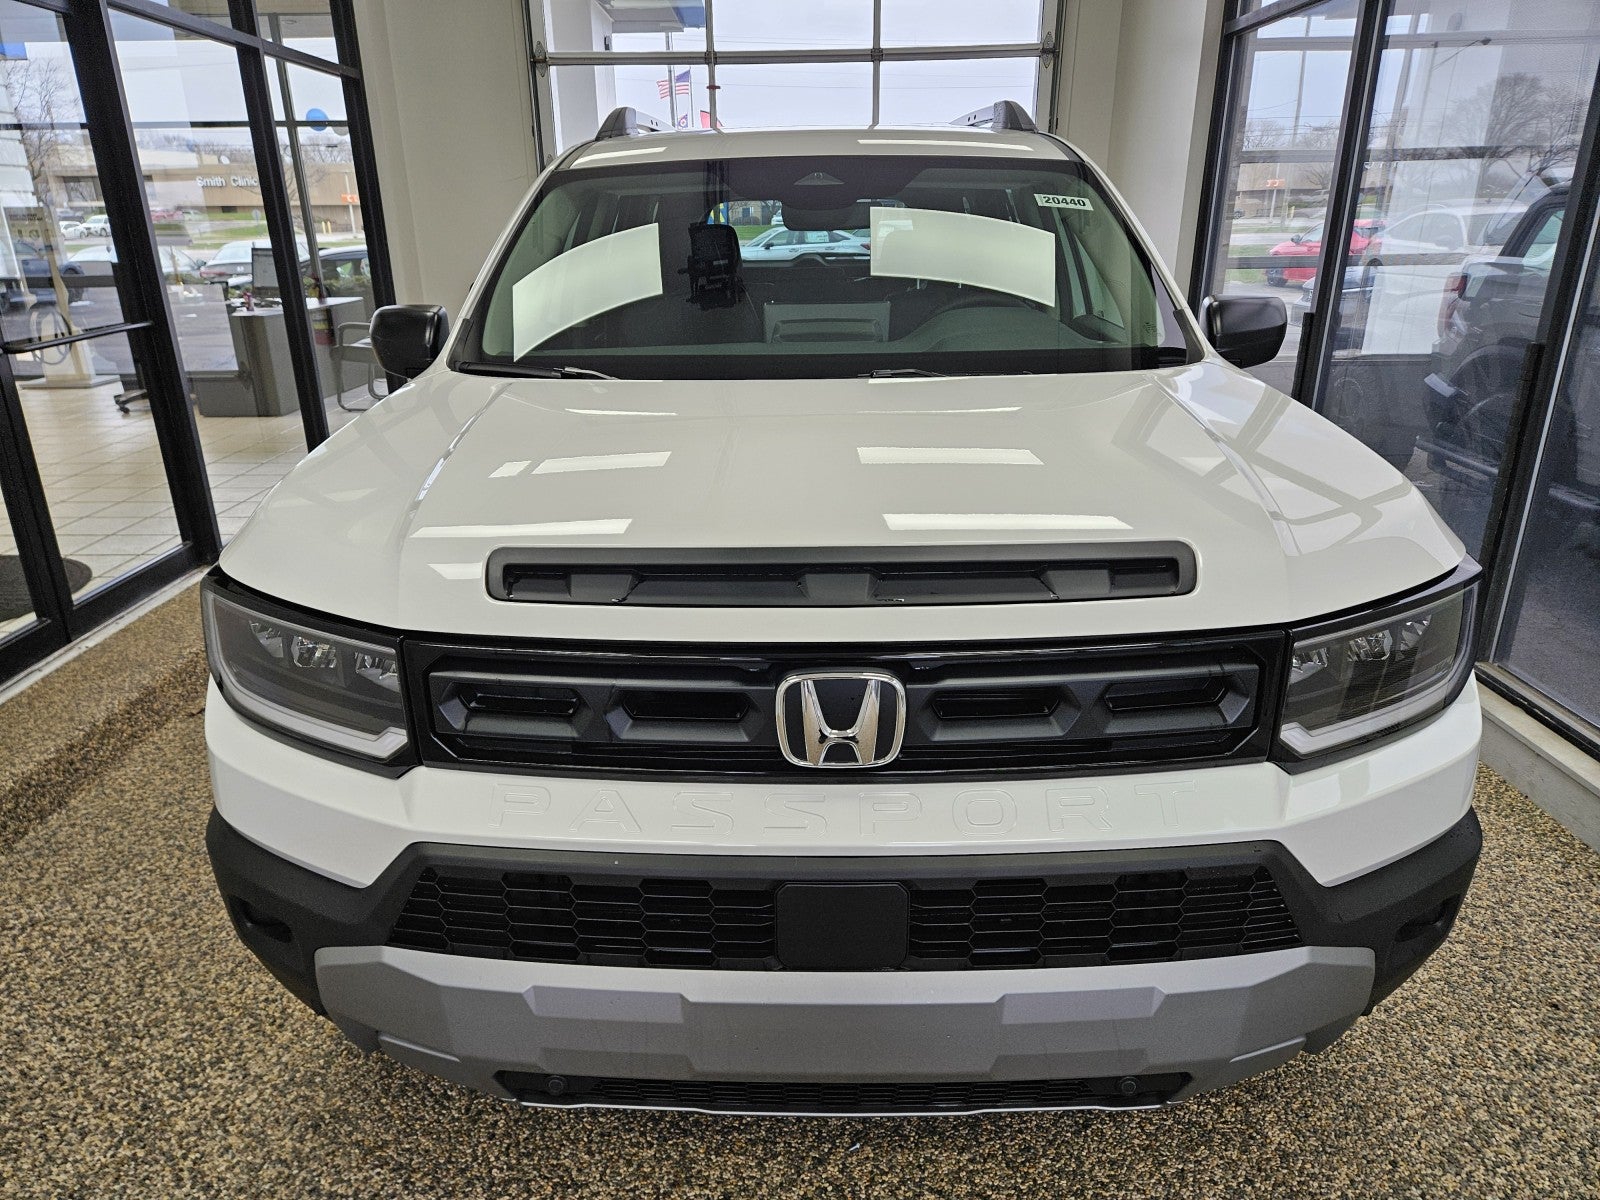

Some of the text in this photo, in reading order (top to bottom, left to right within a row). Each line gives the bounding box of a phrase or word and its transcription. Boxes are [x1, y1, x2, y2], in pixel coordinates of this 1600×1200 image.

[196, 175, 258, 187] Smith Clinic
[1043, 195, 1087, 207] 20440
[488, 779, 1198, 839] PASSPORT
